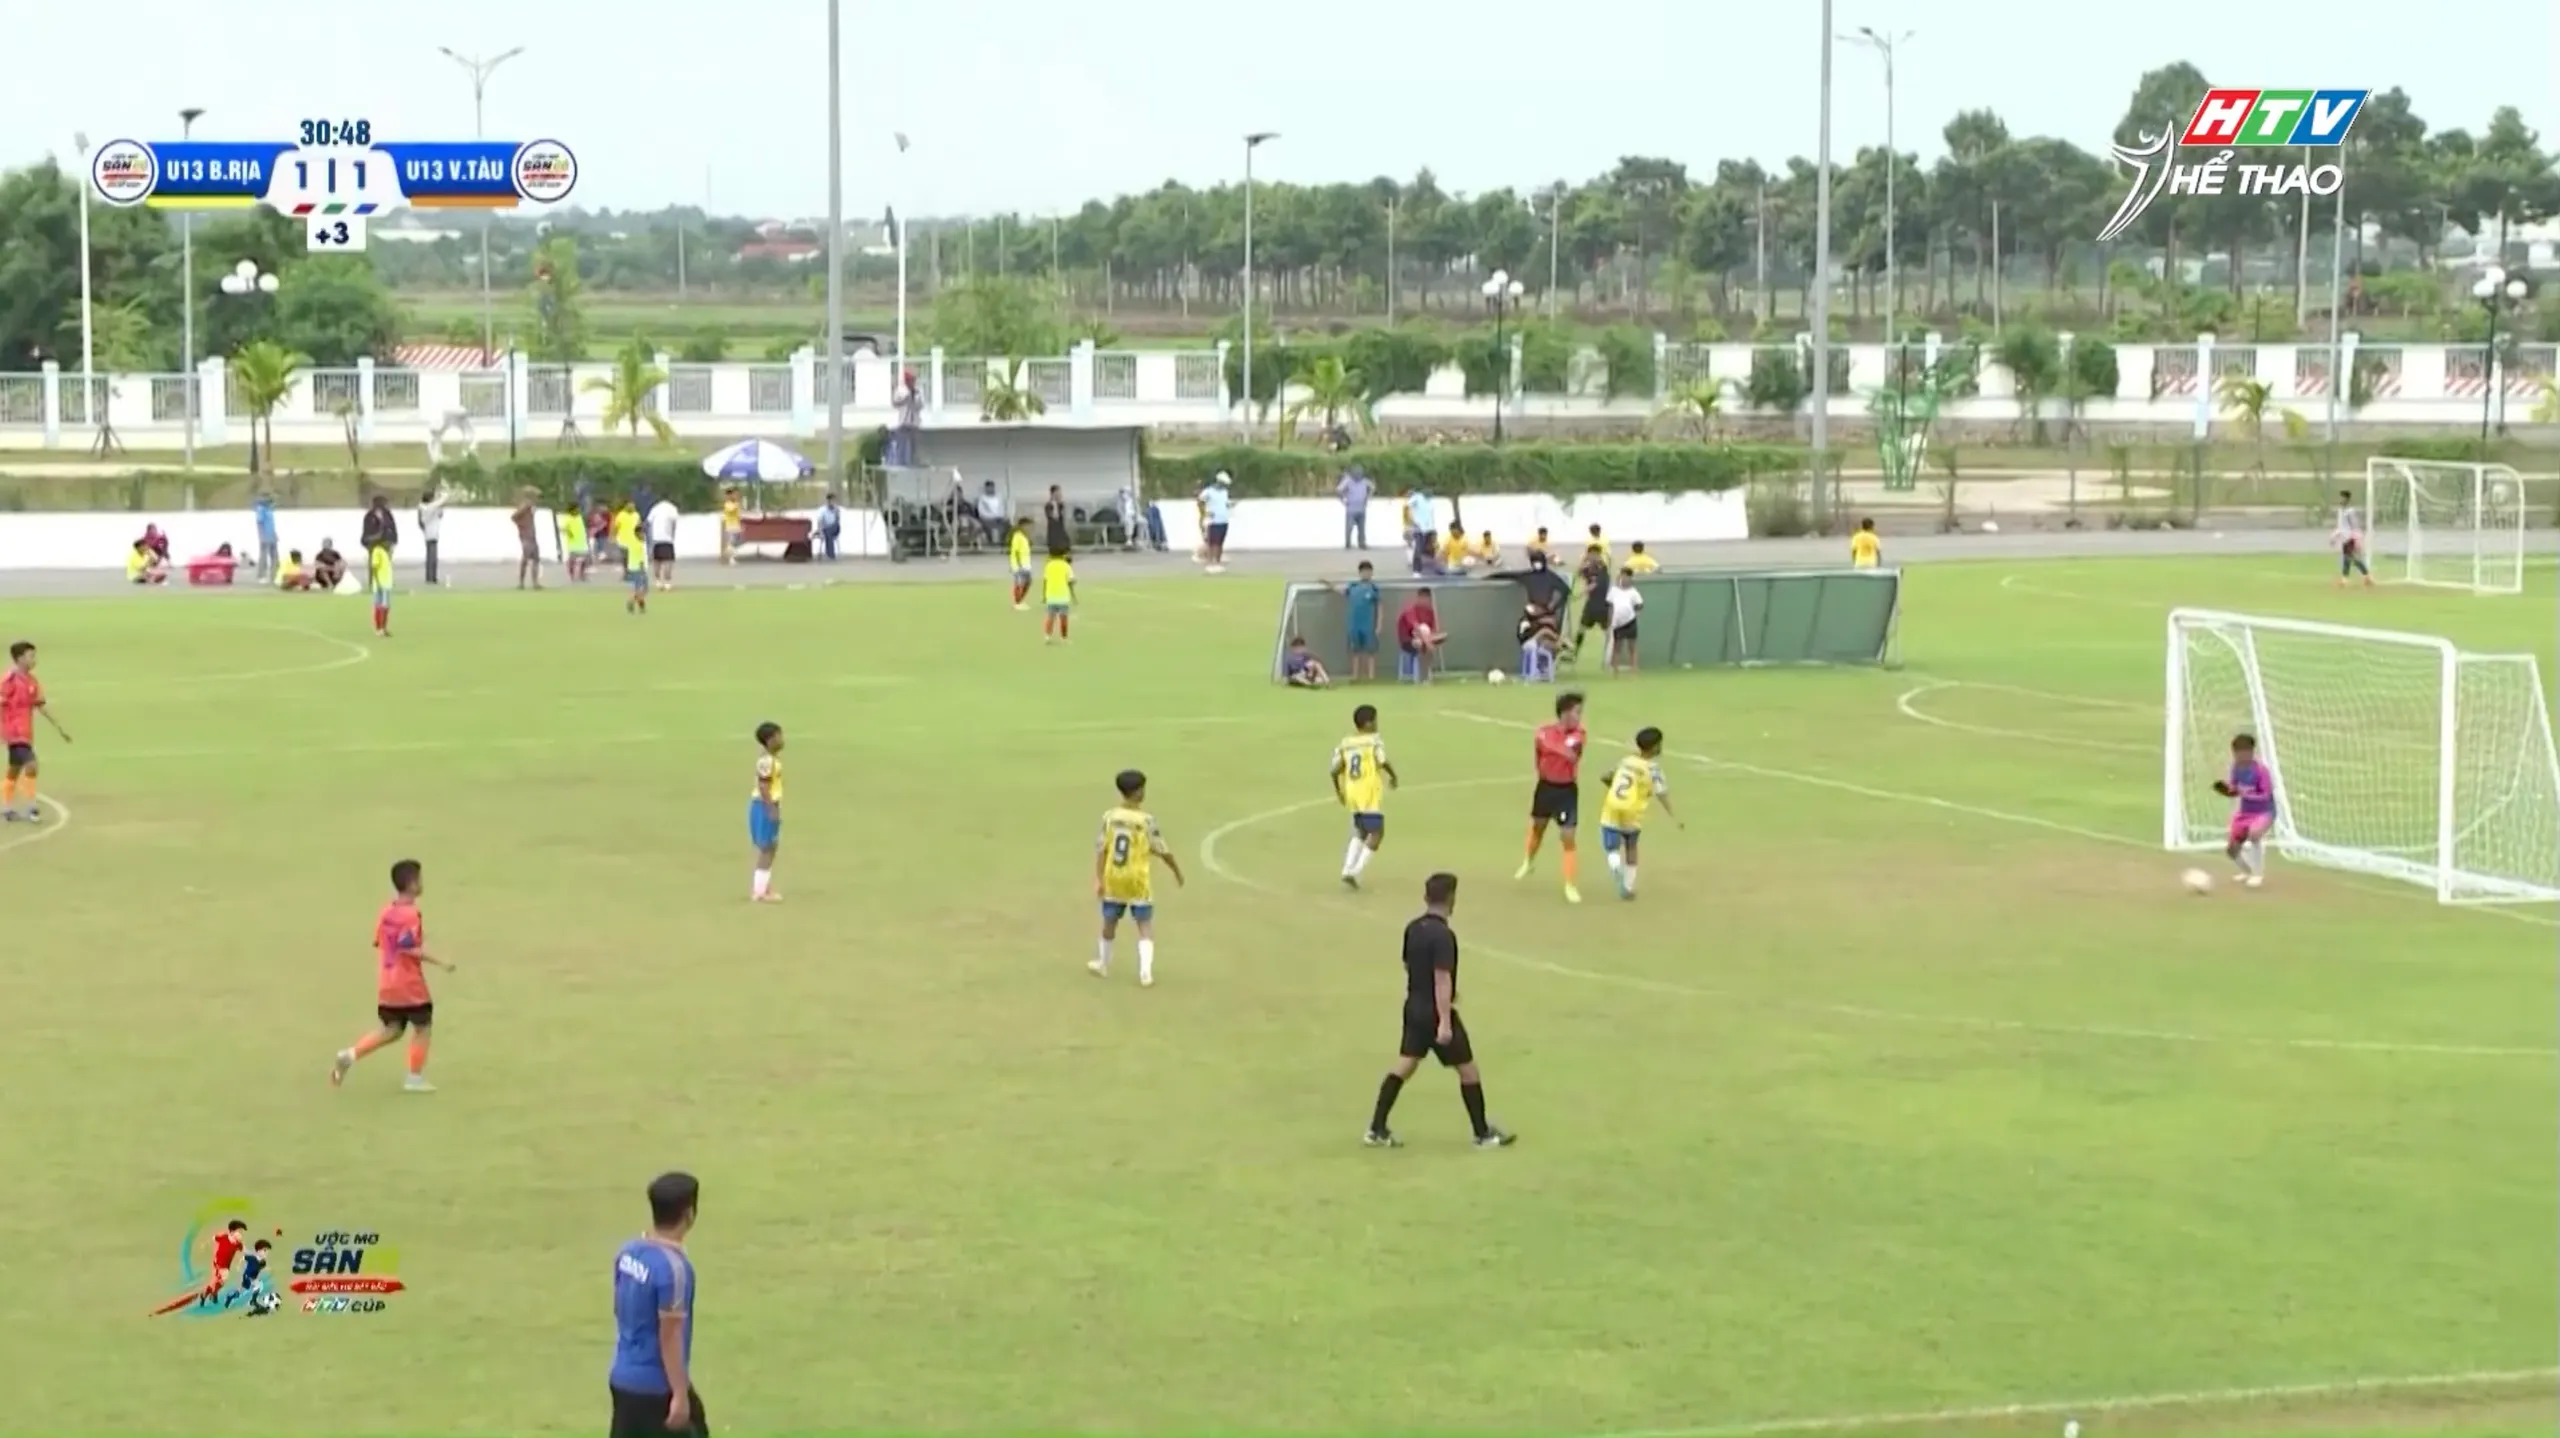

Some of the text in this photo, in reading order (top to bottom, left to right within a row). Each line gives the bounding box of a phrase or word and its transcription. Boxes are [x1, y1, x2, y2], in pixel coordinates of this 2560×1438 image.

[1349, 754, 1362, 779] 8
[1615, 774, 1633, 799] 2
[1112, 833, 1130, 866] 9
